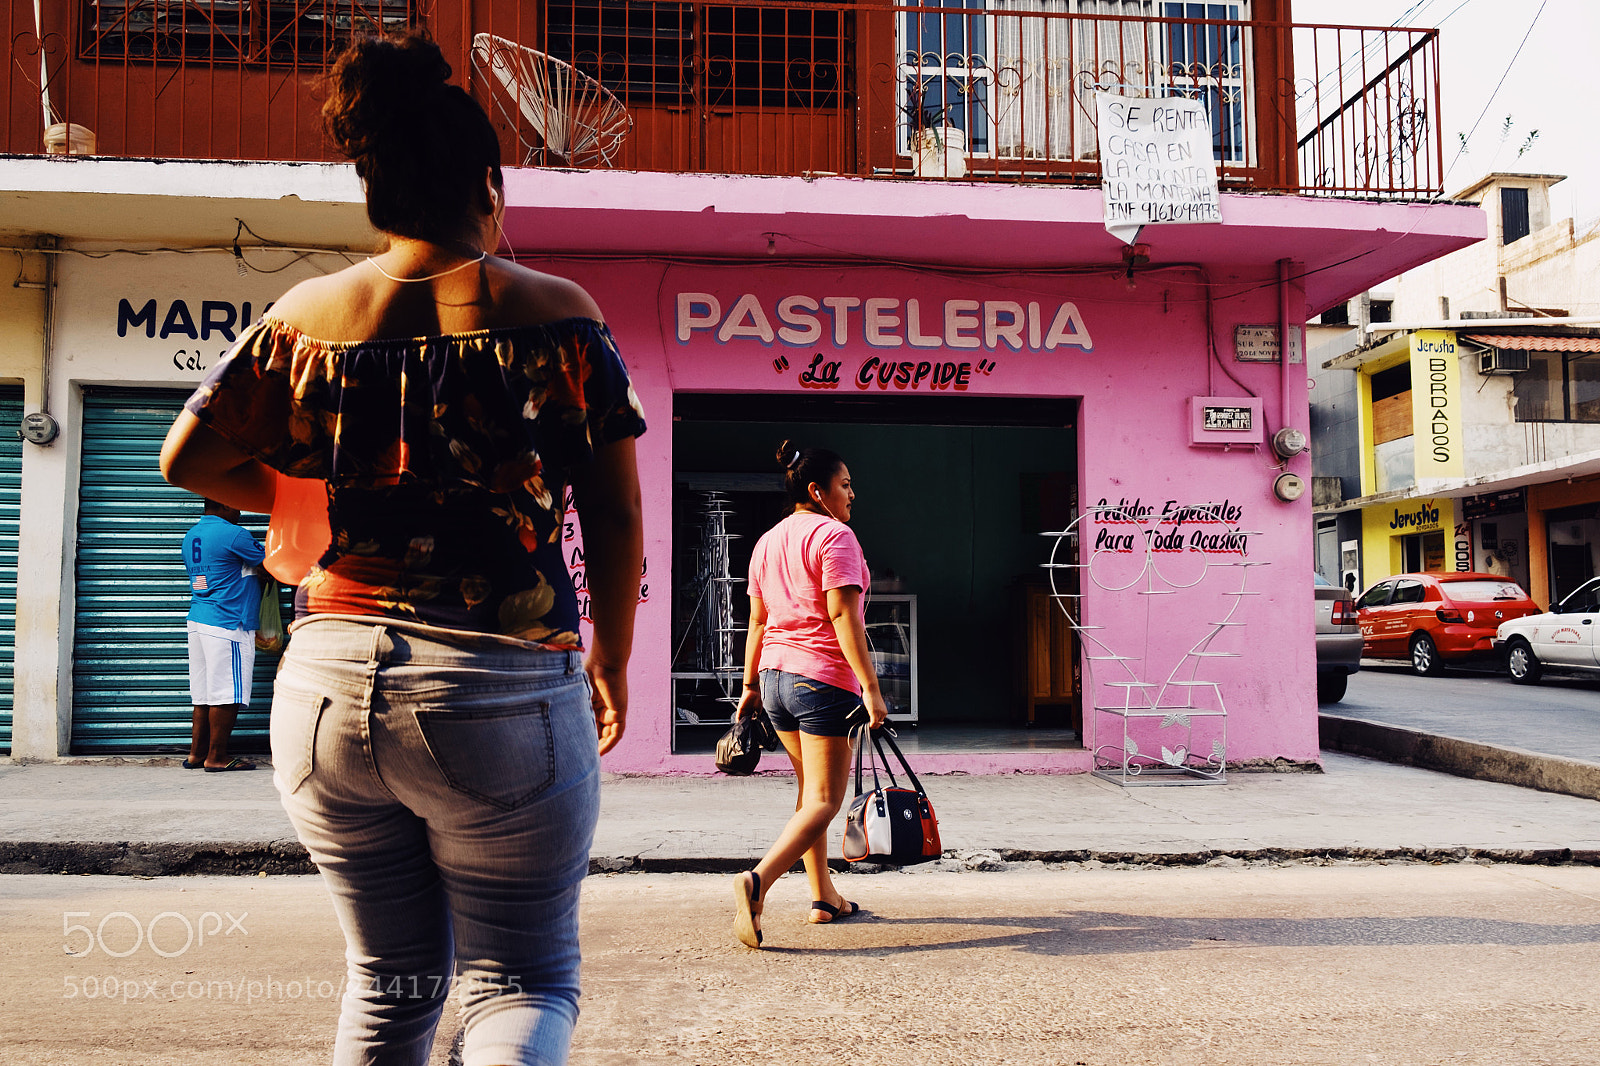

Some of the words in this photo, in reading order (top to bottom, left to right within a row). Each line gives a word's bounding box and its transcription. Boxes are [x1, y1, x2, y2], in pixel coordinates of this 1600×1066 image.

[1108, 102, 1141, 132] SE
[1152, 106, 1208, 132] RENTA
[1108, 134, 1160, 164] CASA
[1167, 141, 1192, 162] EN
[1105, 158, 1130, 178] LA
[1108, 202, 1136, 220] INF
[675, 292, 1095, 351] PASTELERIA
[1417, 338, 1455, 354] Jerusha
[1429, 358, 1450, 463] BORDADOS
[1094, 498, 1155, 522] Pedidos
[1161, 499, 1243, 526] Especiales
[1389, 503, 1440, 530] Jerusha
[192, 537, 202, 564] 6
[1095, 527, 1135, 551] Para
[1143, 526, 1185, 550] Toda
